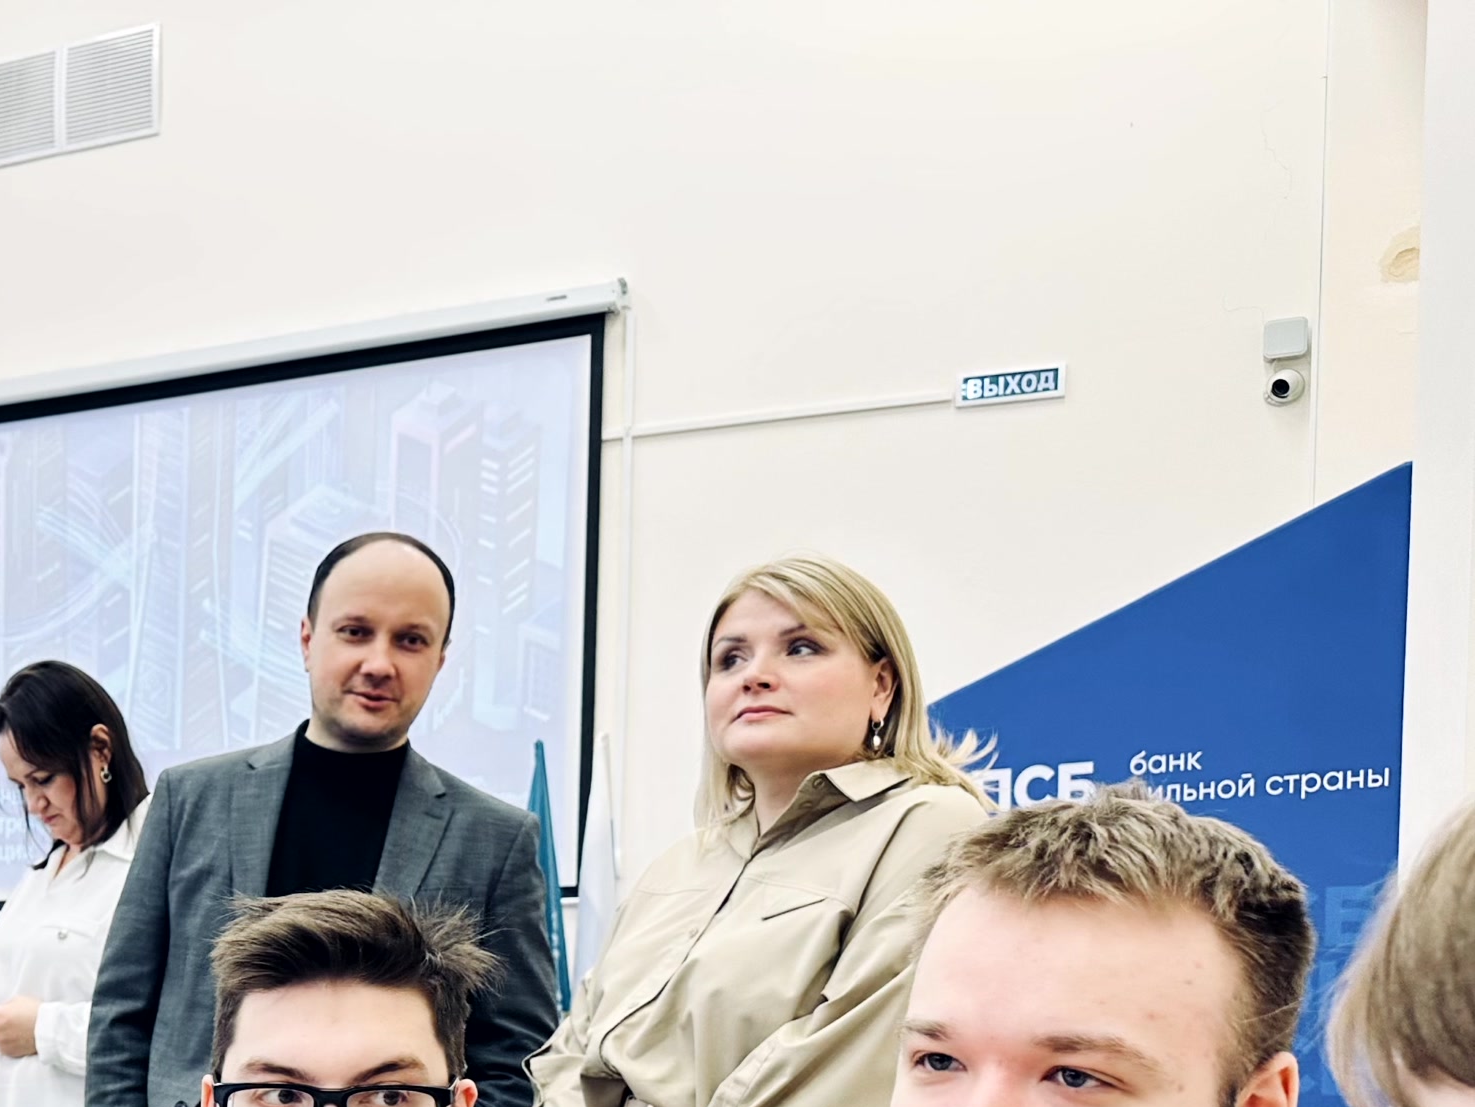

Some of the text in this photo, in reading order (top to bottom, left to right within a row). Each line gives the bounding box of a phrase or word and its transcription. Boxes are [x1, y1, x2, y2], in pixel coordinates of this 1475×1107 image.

[966, 371, 1055, 400] ВЫХОД
[1129, 750, 1202, 776] банк
[1146, 766, 1390, 803] ильной страны
